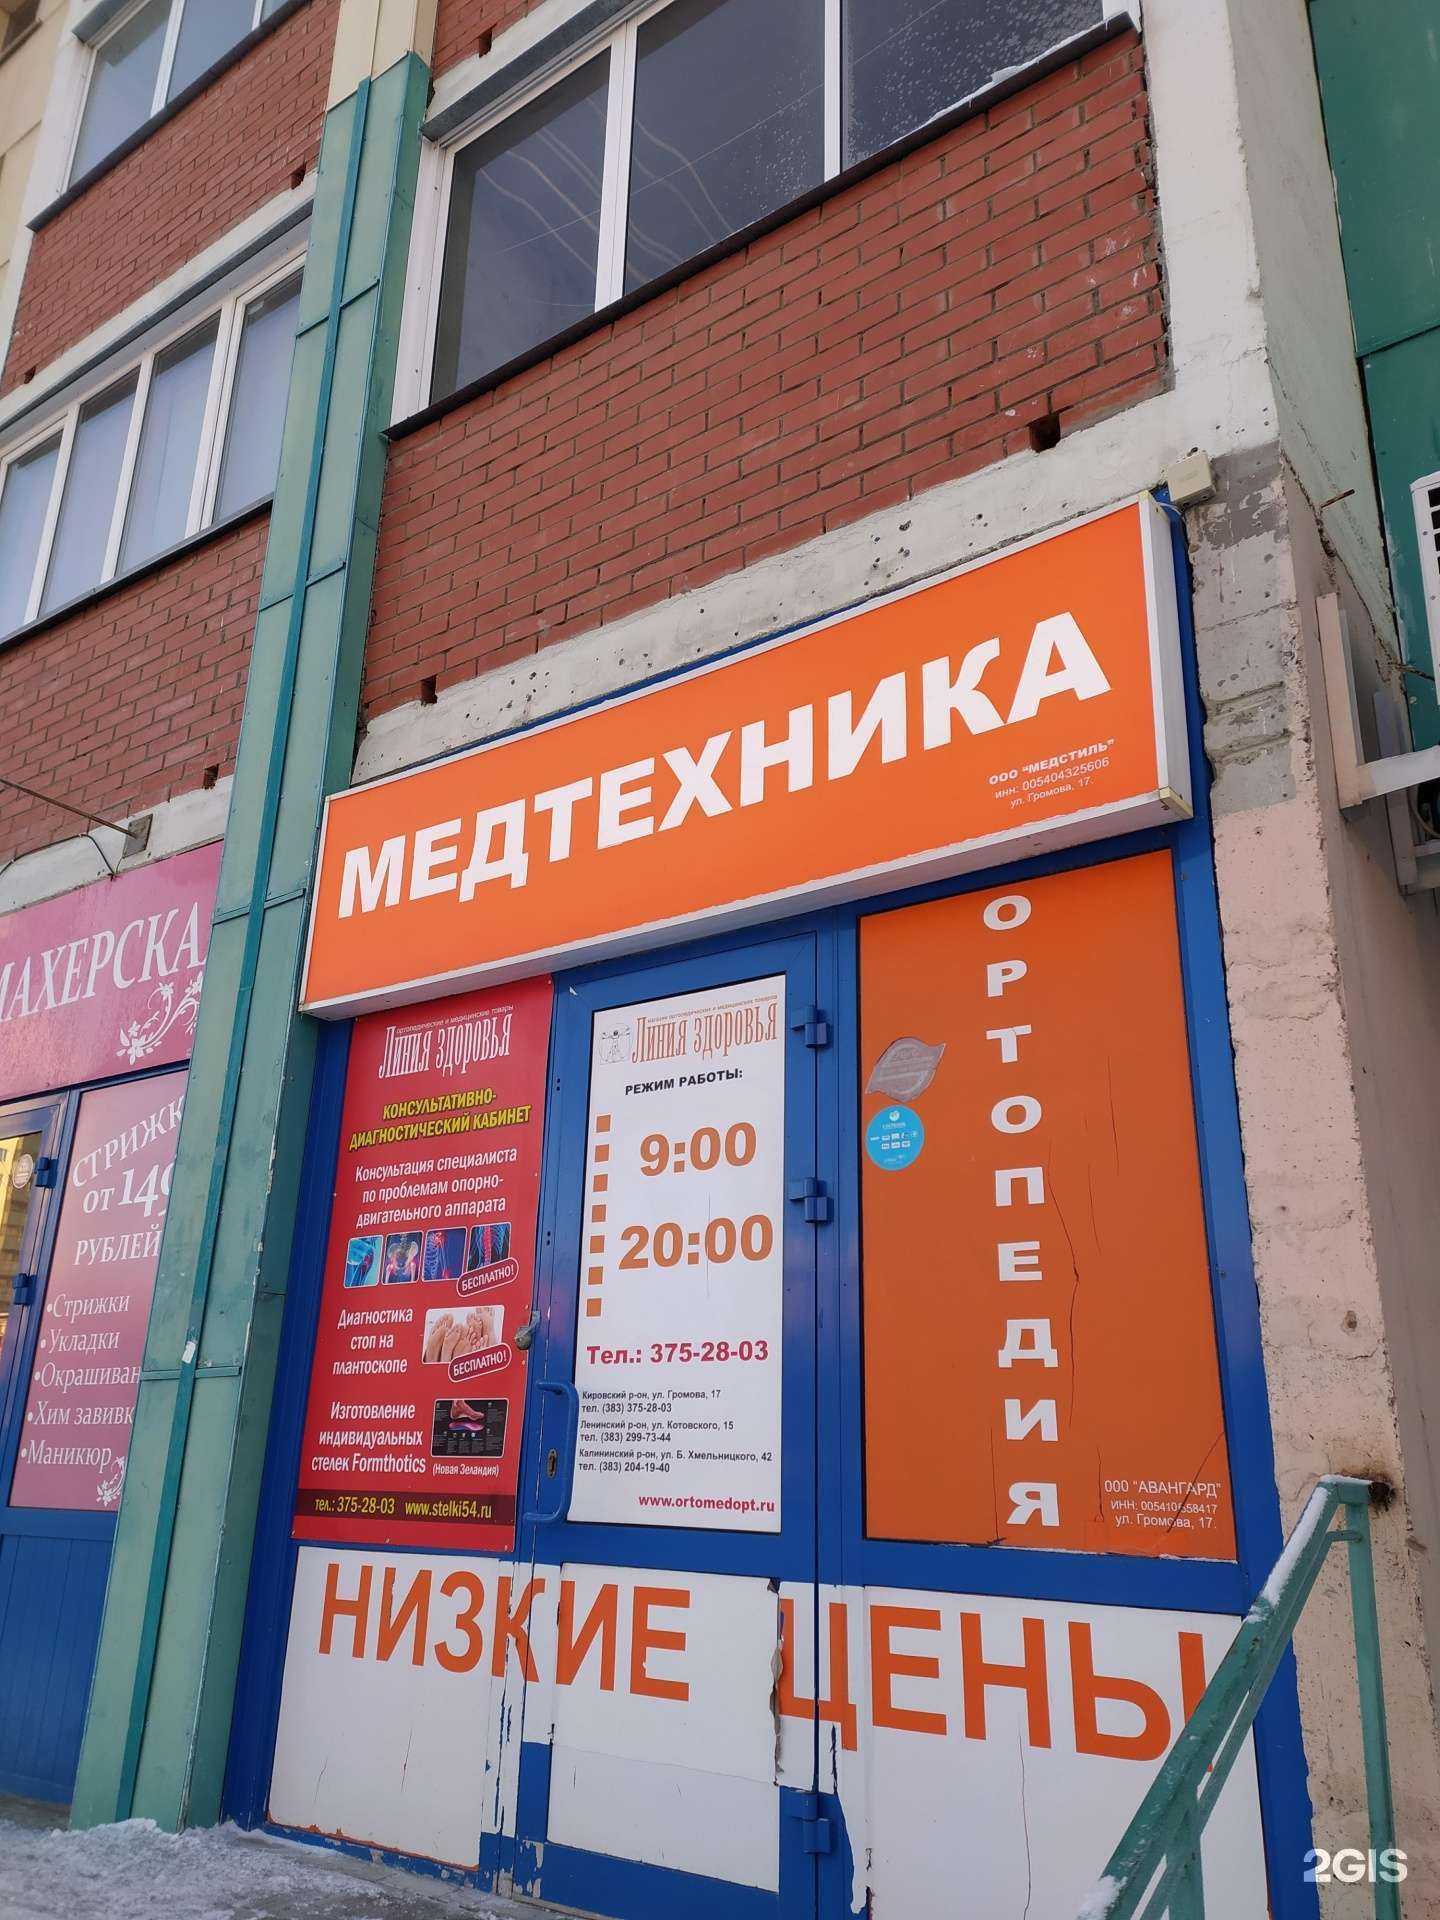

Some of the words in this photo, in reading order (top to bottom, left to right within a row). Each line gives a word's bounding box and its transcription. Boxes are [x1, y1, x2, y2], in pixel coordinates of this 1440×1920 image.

[338, 611, 1112, 919] МЕДТЕХНИКА
[989, 769, 1018, 785] ООО
[1010, 797, 1025, 809] ул.
[624, 1078, 675, 1096] РЕЖИМ
[678, 1068, 744, 1088] РАБОТЫ:
[383, 1087, 497, 1121] КОНСУЛЬТАТИВНО-
[349, 1115, 470, 1151] ДИАГНОСТИЧЕСКИЙ
[472, 1105, 531, 1134] КАБИНЕТ
[639, 1121, 757, 1177] 9:00
[355, 1158, 434, 1183] Консультация
[436, 1148, 517, 1171] специалиста
[362, 1188, 376, 1204] по
[378, 1180, 448, 1205] проблемам
[451, 1175, 504, 1195] опорно-
[356, 1204, 442, 1230] двигательного
[445, 1197, 506, 1218] аппарата
[982, 894, 1061, 1528] ОРТОПЕДИЯ
[72, 1224, 163, 1266] РУБЛЕЙ
[618, 1213, 774, 1271] 20:00
[461, 1265, 515, 1292] БЕСПЛАТНО!
[337, 1307, 413, 1330] Диагностика
[350, 1334, 376, 1351] стоп
[379, 1336, 394, 1349] на
[586, 1345, 642, 1365] Тел.:
[649, 1340, 769, 1364] 375-28-03
[332, 1358, 408, 1376] плантоскопе
[453, 1351, 508, 1377] БЕСПЛАТНО!
[582, 1390, 627, 1401] Кировский
[628, 1391, 651, 1402] р-он,
[652, 1391, 665, 1401] ул.
[667, 1389, 709, 1401] Громова,
[711, 1389, 721, 1399] 17
[35, 1401, 70, 1425] Хим
[330, 1401, 416, 1420] Изготовление
[582, 1403, 600, 1413] тел.
[602, 1402, 625, 1414] (383)
[626, 1402, 672, 1413] 375-28-03
[580, 1419, 626, 1430] Ленинский
[627, 1420, 650, 1431] р-он,
[651, 1421, 665, 1431] ул.
[667, 1420, 721, 1432] Котовского,
[723, 1421, 734, 1431] 15
[319, 1428, 424, 1450] индивидуальных
[580, 1432, 598, 1442] тел.
[600, 1432, 623, 1444] (383)
[625, 1432, 671, 1443] 299-73-44
[27, 1440, 112, 1473] Маникюр
[311, 1456, 349, 1471] стелек
[351, 1452, 426, 1474] Formthotics
[579, 1448, 635, 1459] Калининский
[636, 1450, 659, 1461] р-он,
[660, 1450, 674, 1461] ул.
[676, 1450, 686, 1459] Б.
[688, 1450, 759, 1462] Хмельницкого,
[761, 1451, 773, 1462] 42
[432, 1463, 459, 1476] (Новая
[460, 1464, 499, 1478] Зеландия)
[579, 1461, 597, 1471] тел.
[599, 1461, 622, 1474] (383)
[624, 1461, 670, 1473] 204-19-40
[336, 1497, 395, 1515] 375-28-03
[404, 1501, 492, 1520] www.stelki54.ru
[638, 1494, 775, 1513] www.ortomedopt.ru
[1111, 1500, 1138, 1511] ИНН:
[1115, 1514, 1133, 1527] ул.
[1136, 1513, 1195, 1530] Громова,
[318, 1562, 691, 1702] НИЗКИЕ
[778, 1597, 1212, 1773] ЦЕНЫ
